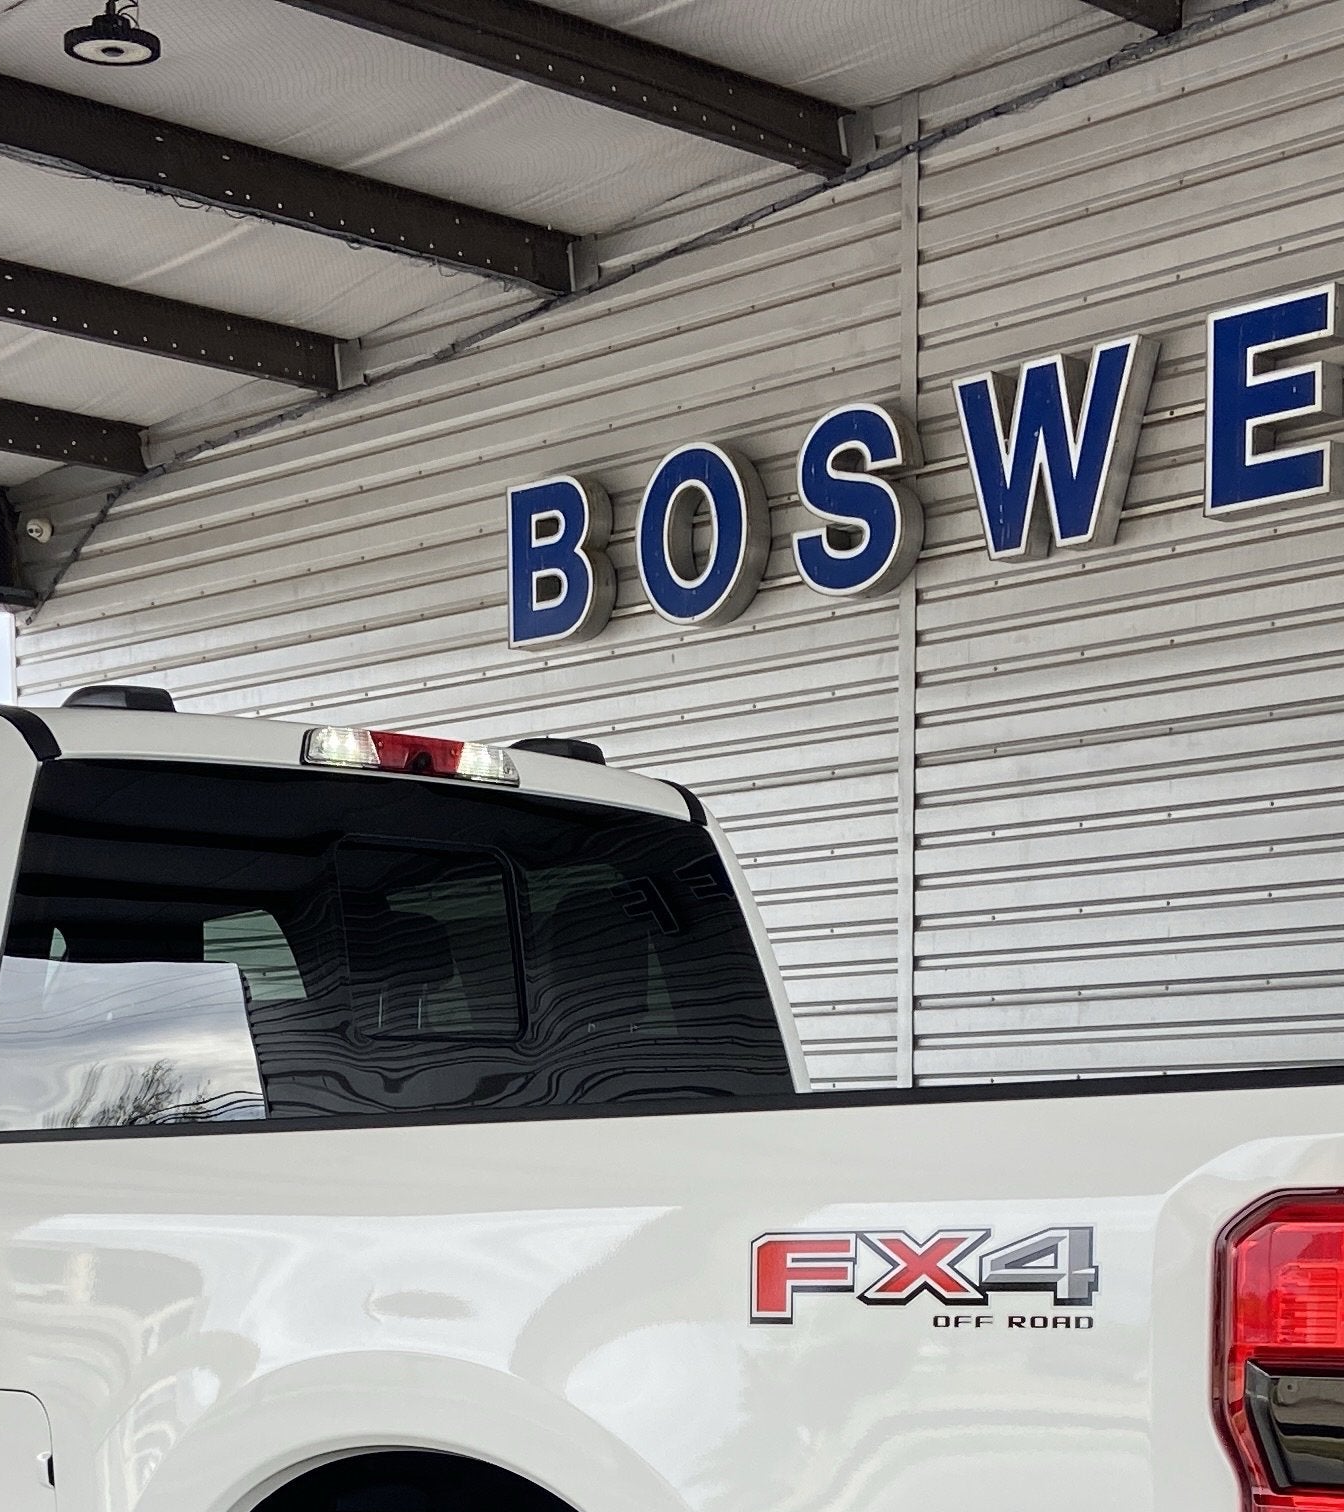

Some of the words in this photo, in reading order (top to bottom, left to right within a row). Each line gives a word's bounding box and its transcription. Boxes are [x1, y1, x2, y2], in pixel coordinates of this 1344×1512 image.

[751, 1227, 1099, 1325] FX4
[932, 1315, 994, 1328] OFF
[1008, 1315, 1094, 1329] ROAD
